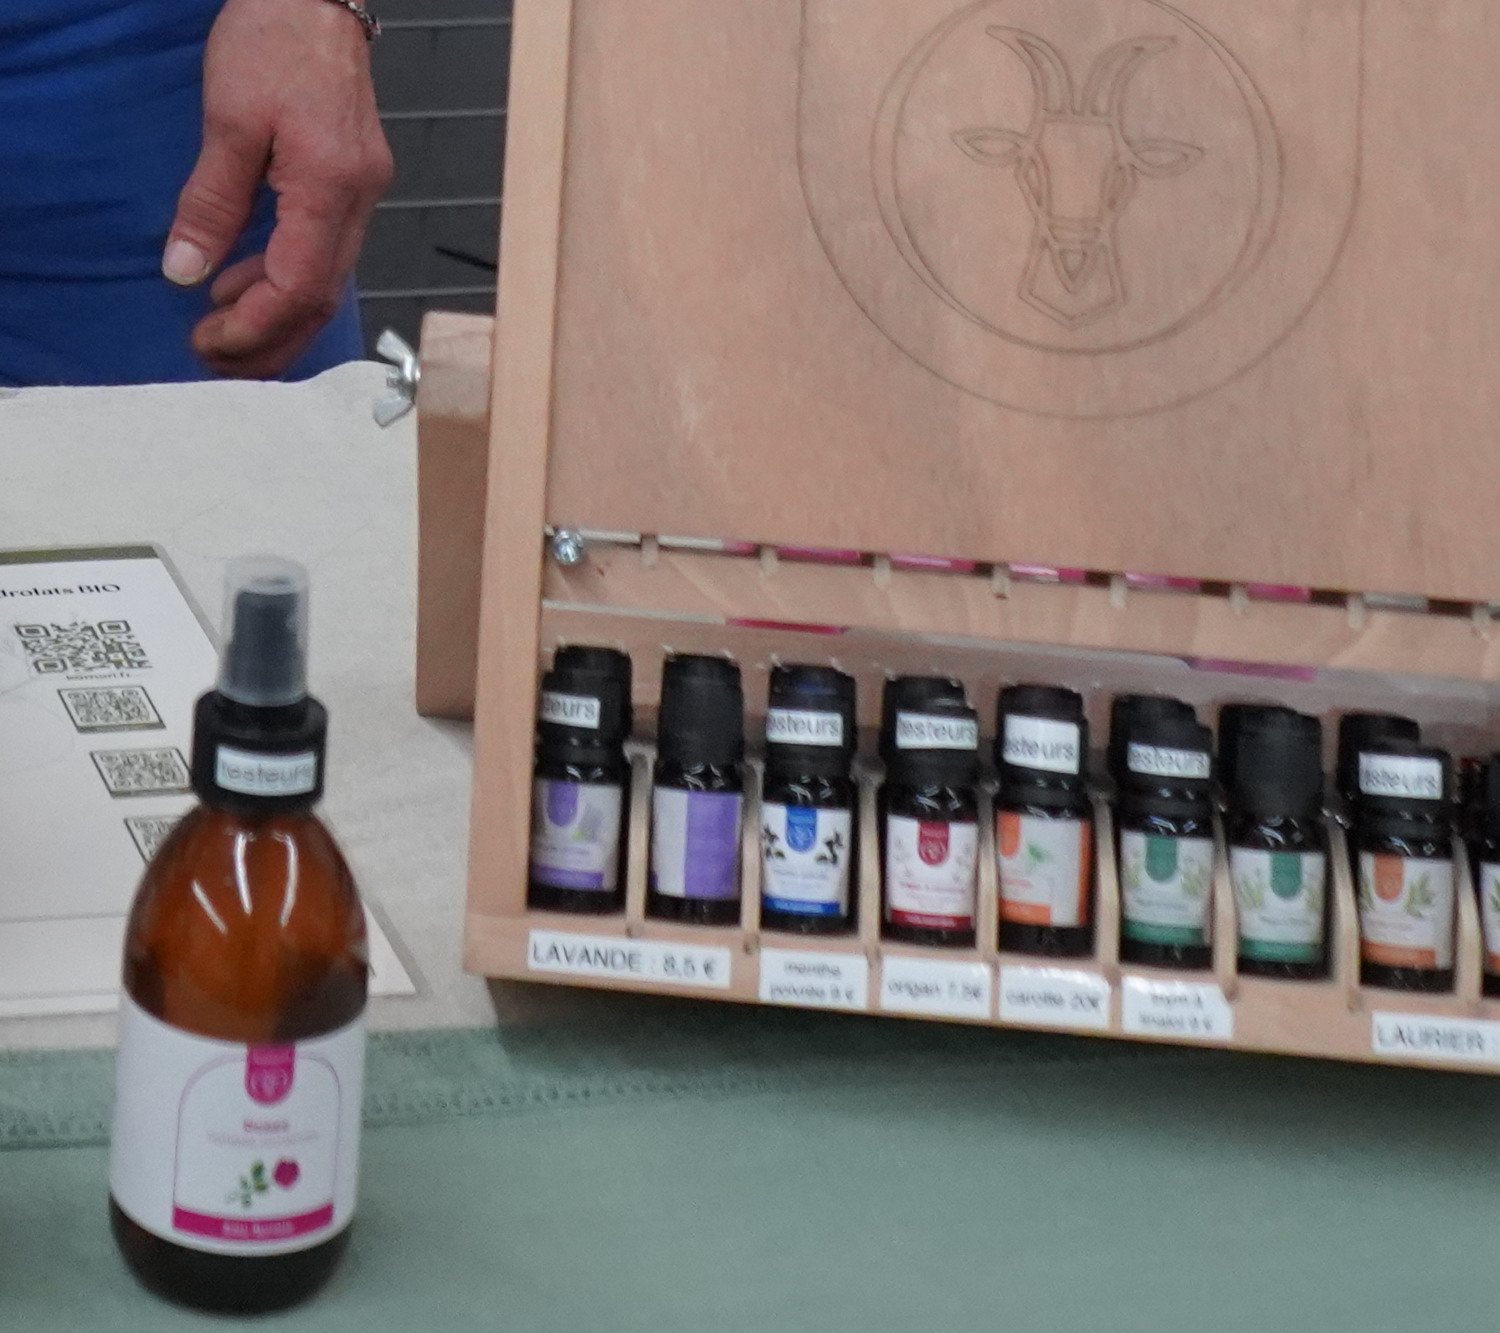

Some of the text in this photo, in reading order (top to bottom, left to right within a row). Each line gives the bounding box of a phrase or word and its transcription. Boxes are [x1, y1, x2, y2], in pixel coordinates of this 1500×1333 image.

[78, 583, 121, 595] BIO
[532, 940, 643, 973] LAVANDE
[1376, 1023, 1485, 1054] LAURIER
